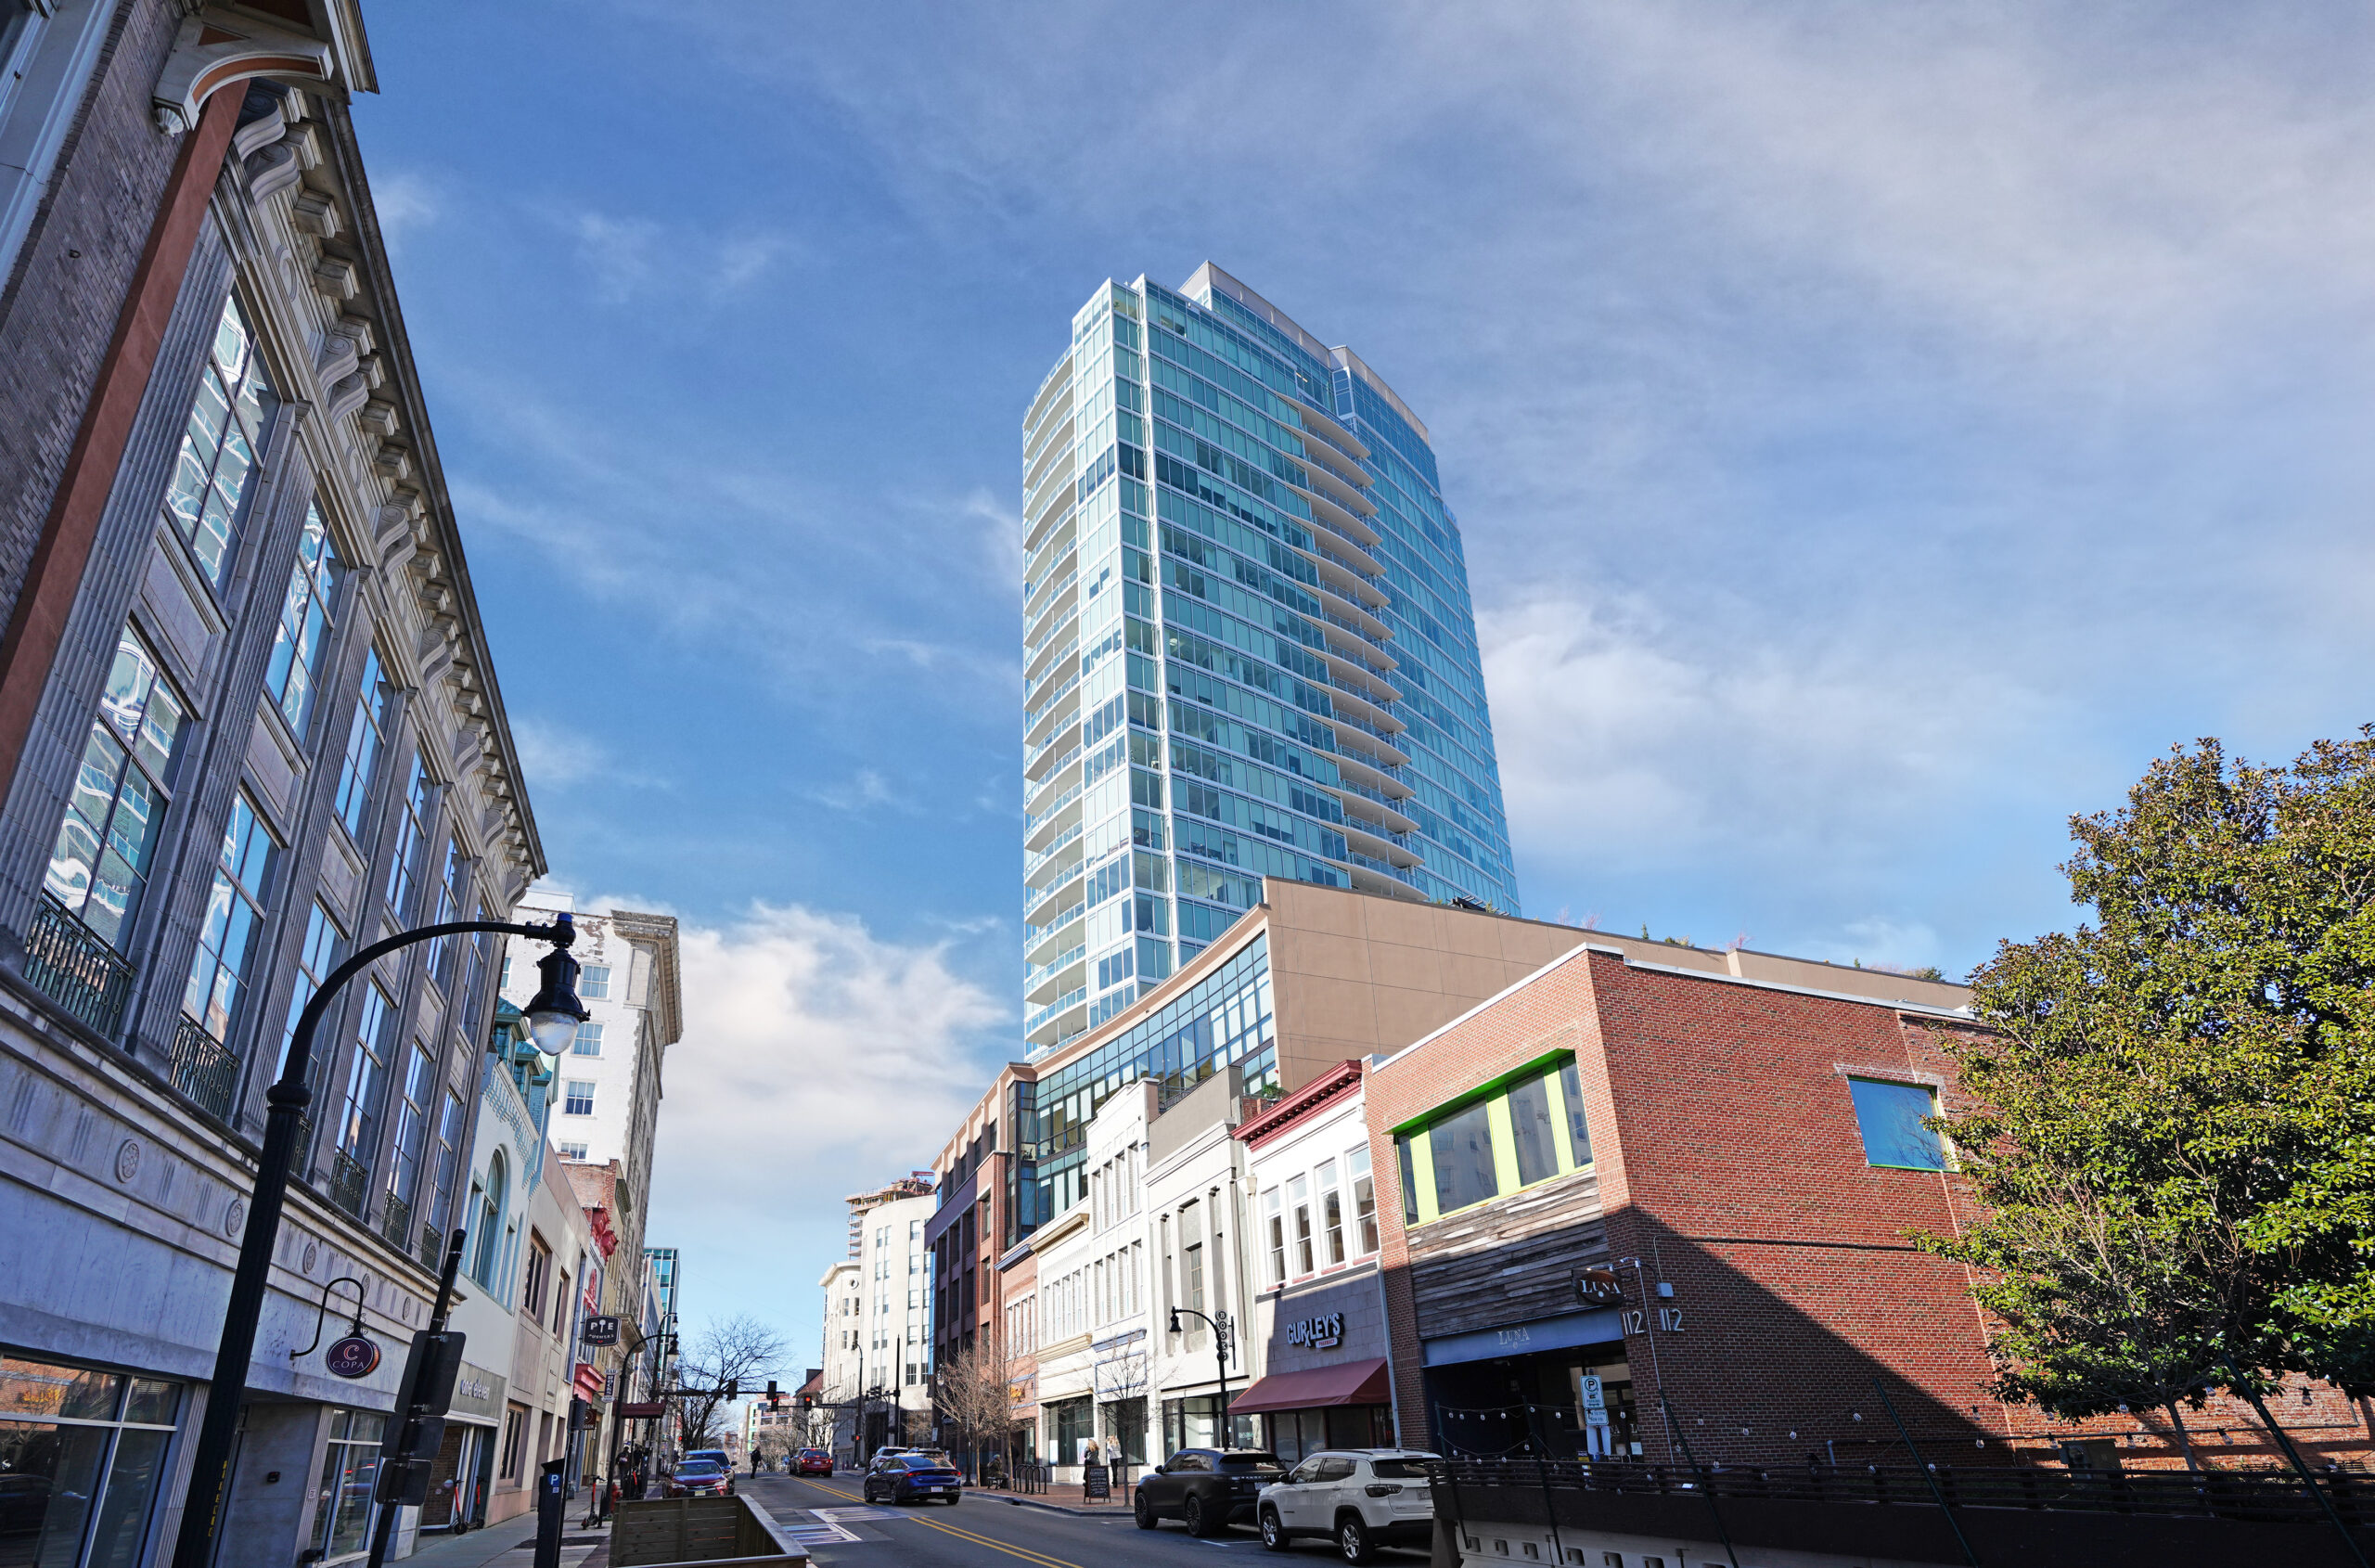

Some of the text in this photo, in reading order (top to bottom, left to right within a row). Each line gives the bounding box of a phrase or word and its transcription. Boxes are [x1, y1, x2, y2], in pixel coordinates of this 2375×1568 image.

[1580, 1279, 1622, 1294] LUNA
[1623, 1310, 1647, 1335] 112
[1661, 1308, 1685, 1331] 112
[1497, 1326, 1531, 1345] LUNA
[343, 1344, 360, 1361] C
[332, 1360, 365, 1369] COPA
[1587, 1380, 1596, 1390] P
[550, 1474, 558, 1485] P
